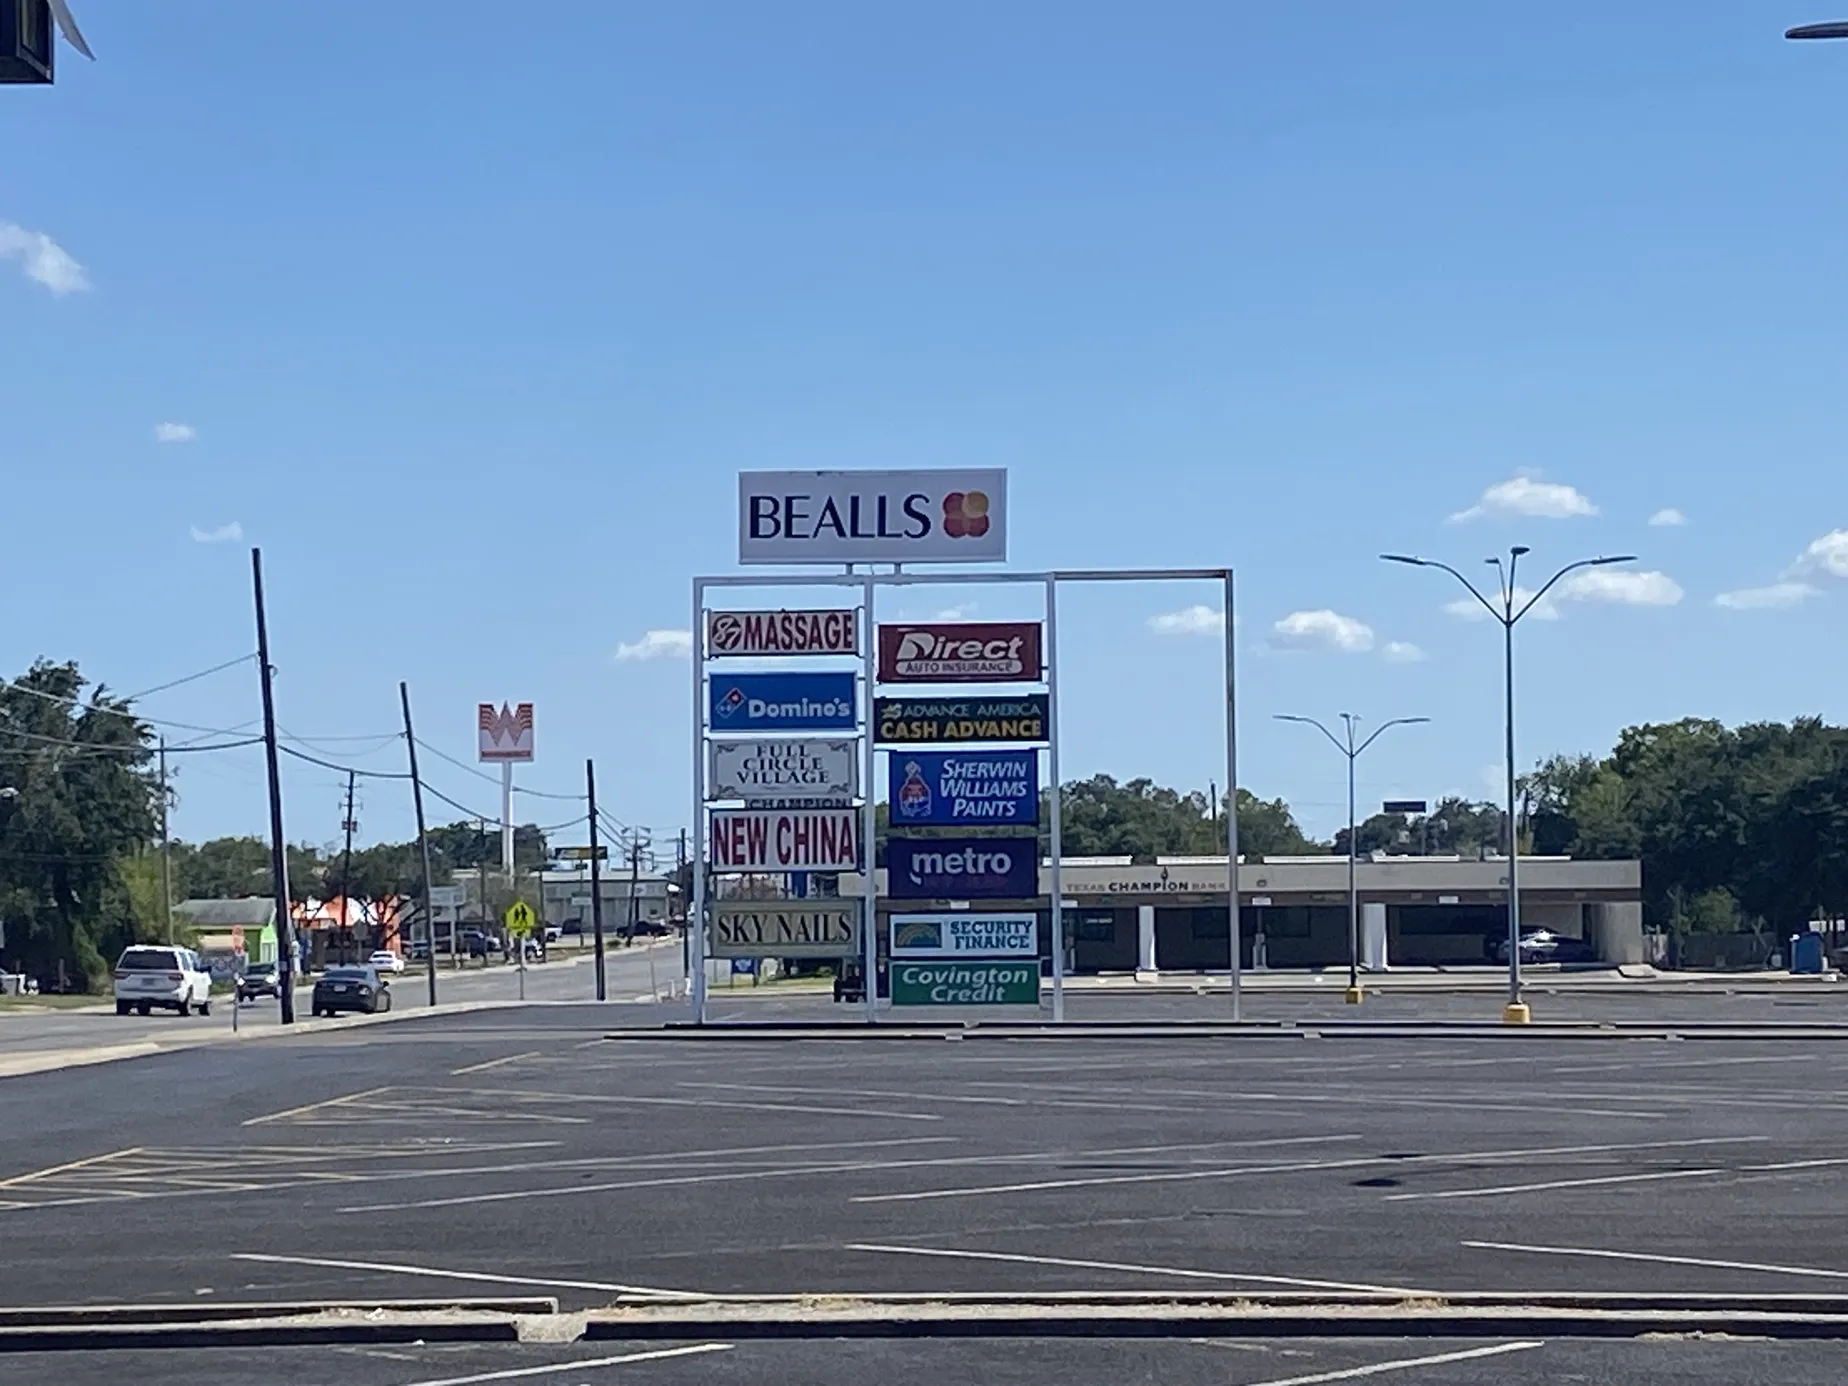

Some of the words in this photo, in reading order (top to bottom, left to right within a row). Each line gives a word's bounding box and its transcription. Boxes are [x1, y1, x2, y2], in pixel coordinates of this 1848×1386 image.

[749, 493, 931, 539] BEALLS
[743, 615, 853, 650] MASSAGE
[896, 632, 1023, 660] Direct
[905, 662, 940, 673] AUTO
[942, 662, 1012, 673] INSURANCE
[748, 698, 850, 718] Domino's
[903, 704, 970, 717] ADVANCE
[976, 703, 1041, 717] AMERICA
[880, 722, 937, 738] CASH
[943, 720, 1041, 738] ADVANCE
[756, 744, 811, 758] FULL
[743, 757, 824, 771] CIRCLE
[941, 759, 1027, 779] SHERWIN
[736, 770, 830, 785] VILLAGE
[940, 779, 1027, 798] WILLIAMS
[952, 798, 1016, 817] PAINTS
[714, 817, 768, 866] NEW
[776, 816, 854, 865] CHINA
[911, 848, 1012, 874] metro
[1108, 881, 1188, 892] CHAMPION
[718, 914, 767, 942] SKY
[778, 913, 851, 942] NAILS
[951, 920, 1032, 934] SECURITY
[955, 935, 1029, 949] FINANCE
[902, 966, 1028, 988] Covington
[931, 983, 1005, 1001] Credit
